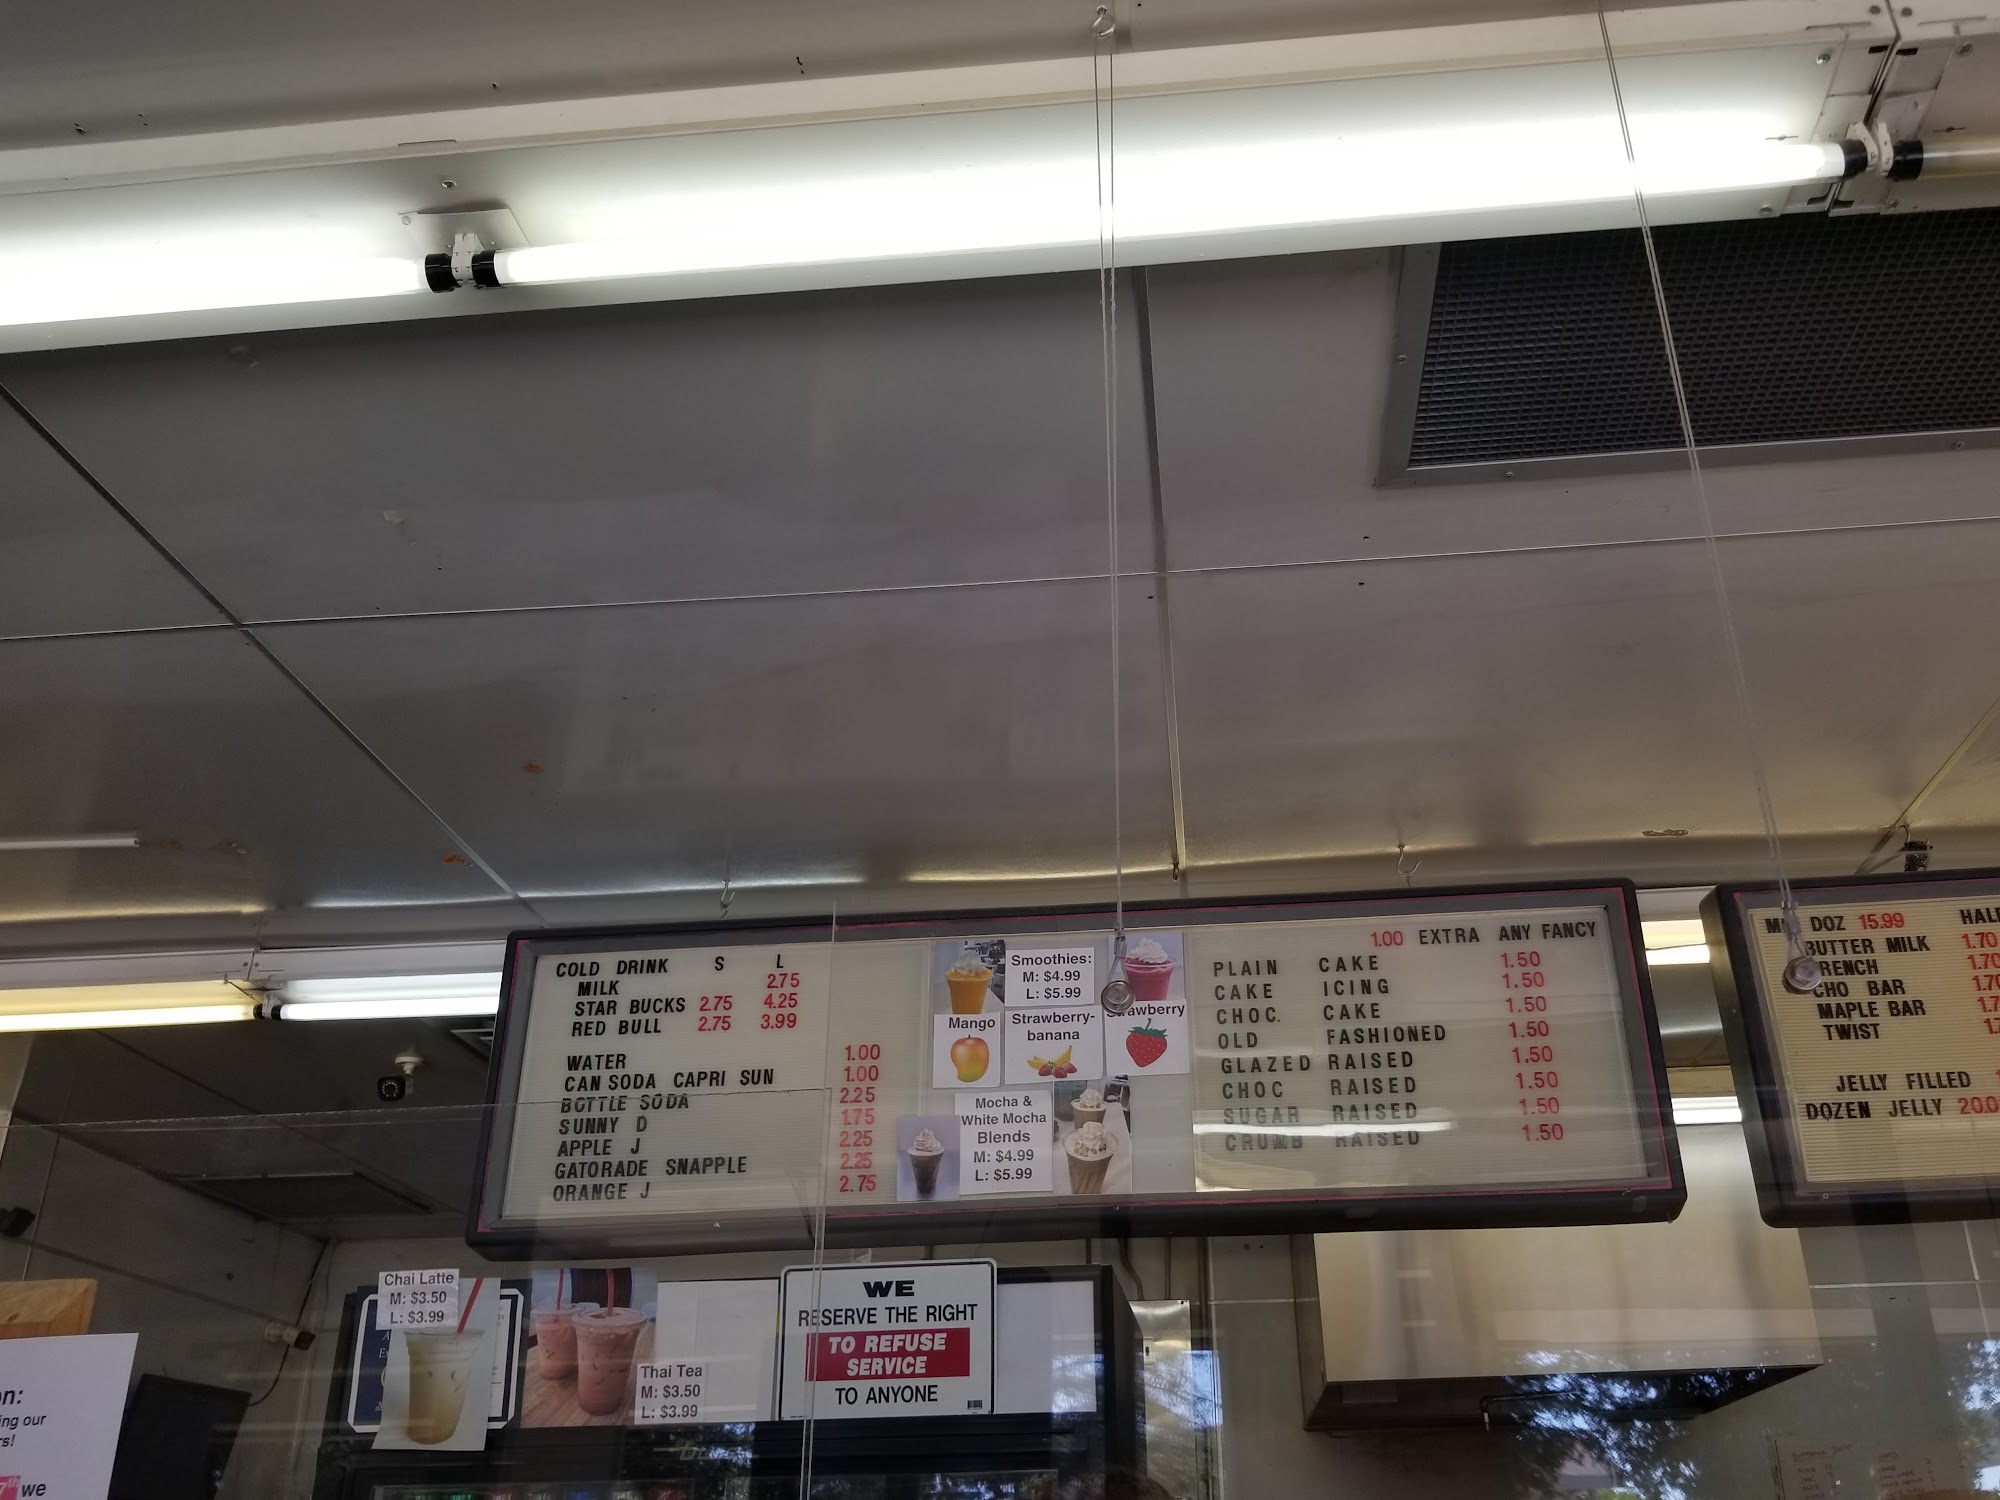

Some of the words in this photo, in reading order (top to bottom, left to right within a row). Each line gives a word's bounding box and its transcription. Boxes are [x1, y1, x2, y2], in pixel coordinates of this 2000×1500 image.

[1810, 915, 1846, 931] DOZ
[1858, 913, 1905, 929] 15.99
[1370, 930, 1404, 947] 1.00
[1418, 927, 1480, 945] EXTRA
[1499, 924, 1531, 941] ANY
[1541, 921, 1597, 940] FANCY
[1804, 939, 1875, 956] BUTTER
[1886, 935, 1930, 953] MILK
[1961, 932, 1998, 949] 1.70
[556, 961, 600, 977] COLD
[617, 958, 669, 974] DRINK
[714, 956, 725, 971] S
[776, 954, 785, 969] L
[1011, 952, 1092, 967] Smoothies:
[1213, 959, 1278, 977] PLAIN
[1318, 955, 1379, 973] CAKE
[1500, 951, 1541, 969] 1.50
[1817, 959, 1879, 976] RENCH
[577, 980, 620, 996] MILK
[767, 973, 800, 989] 2.75
[1022, 971, 1040, 983] M:
[1043, 970, 1081, 983] $4.99
[1214, 983, 1274, 1001] CAKE
[1323, 979, 1390, 997] ICING
[1502, 971, 1545, 989] 1.50
[1026, 988, 1040, 1000] L:
[1043, 987, 1081, 1000] $5.99
[1813, 981, 1849, 998] CHO
[1867, 979, 1906, 996] BAR
[574, 1000, 618, 1016] STAR
[629, 997, 686, 1014] BUCKS
[699, 996, 733, 1012] 2.75
[763, 993, 798, 1009] 4.25
[1106, 1004, 1185, 1018] awberry
[1216, 1007, 1281, 1025] CHOC.
[1323, 1003, 1381, 1021] CAKE
[1505, 996, 1548, 1014] 1.50
[1817, 1001, 1880, 1019] MAPLE
[1888, 999, 1926, 1017] BAR
[571, 1021, 606, 1037] RED
[618, 1019, 662, 1035] BULL
[697, 1015, 731, 1032] 2.75
[760, 1013, 797, 1030] 3.99
[949, 1016, 996, 1031] Mango
[1011, 1010, 1095, 1026] Strawberry-
[1027, 1029, 1080, 1041] banana
[1217, 1032, 1259, 1049] OLD
[1327, 1024, 1446, 1045] FASHIONED
[1508, 1020, 1550, 1038] 1.50
[1823, 1023, 1880, 1040] TWIST
[566, 1054, 627, 1071] WATER
[844, 1044, 881, 1061] 1.00
[1221, 1054, 1311, 1074] GLAZED
[1328, 1050, 1414, 1070] RAISED
[1511, 1046, 1554, 1064] 1.50
[564, 1075, 601, 1092] CAN
[608, 1073, 656, 1090] SODA
[673, 1070, 726, 1088] CAPRI
[739, 1069, 774, 1086] SUN
[843, 1066, 879, 1082] 1.00
[1221, 1080, 1284, 1099] CHOC
[1330, 1076, 1417, 1096] RAISED
[1515, 1071, 1559, 1089] 1.50
[1836, 1074, 1888, 1092] JELLY
[1906, 1071, 1971, 1089] FILLED
[560, 1095, 628, 1113] BOTTLE
[640, 1091, 689, 1110] SODA
[840, 1087, 875, 1104] 2.25
[975, 1096, 1019, 1109] Mocha
[1022, 1096, 1033, 1107] &
[1806, 1102, 1871, 1120] DOZEN
[1888, 1099, 1943, 1118] JELLY
[961, 1114, 999, 1126] White
[1002, 1113, 1047, 1125] Mocha
[1223, 1105, 1300, 1124] SUGAR
[1332, 1102, 1417, 1121] RAISED
[1519, 1097, 1560, 1115] 1.50
[558, 1117, 619, 1136] SUNNY
[636, 1115, 648, 1133] D
[841, 1108, 875, 1126] 1.75
[977, 1130, 1031, 1144] Blends
[1522, 1124, 1564, 1142] 1.50
[557, 1139, 612, 1157] APPLE
[630, 1138, 641, 1155] J
[839, 1130, 873, 1147] 2.25
[554, 1160, 648, 1179] GATORADE
[666, 1156, 747, 1175] SNAPPLE
[840, 1153, 873, 1170] 2.25
[973, 1151, 991, 1164] M:
[995, 1149, 1034, 1163] $4.99
[975, 1169, 989, 1181] L:
[994, 1168, 1033, 1182] $5.99
[553, 1183, 628, 1202] ORANGE
[640, 1182, 651, 1199] J
[839, 1175, 877, 1193] 2.75
[384, 1272, 415, 1286] Chai
[419, 1272, 455, 1285] Latte
[862, 1280, 915, 1298] WE
[389, 1292, 407, 1305] M:
[410, 1290, 447, 1305] $3.50
[390, 1312, 403, 1324] L:
[407, 1310, 445, 1324] $3.99
[798, 1307, 877, 1327] RESERVE
[885, 1305, 918, 1323] THE
[925, 1303, 978, 1322] RIGHT
[828, 1336, 856, 1354] TO
[864, 1332, 947, 1353] REFUSE
[641, 1365, 672, 1379] Thai
[677, 1364, 703, 1378] Tea
[847, 1356, 927, 1377] SERVICE
[641, 1386, 658, 1399] M:
[662, 1384, 701, 1399] $3.50
[835, 1387, 858, 1405] TO
[866, 1384, 938, 1404] ANYONE
[23, 1414, 46, 1427] our
[642, 1406, 655, 1419] L:
[660, 1404, 698, 1419] $3.99
[22, 1483, 46, 1497] we
